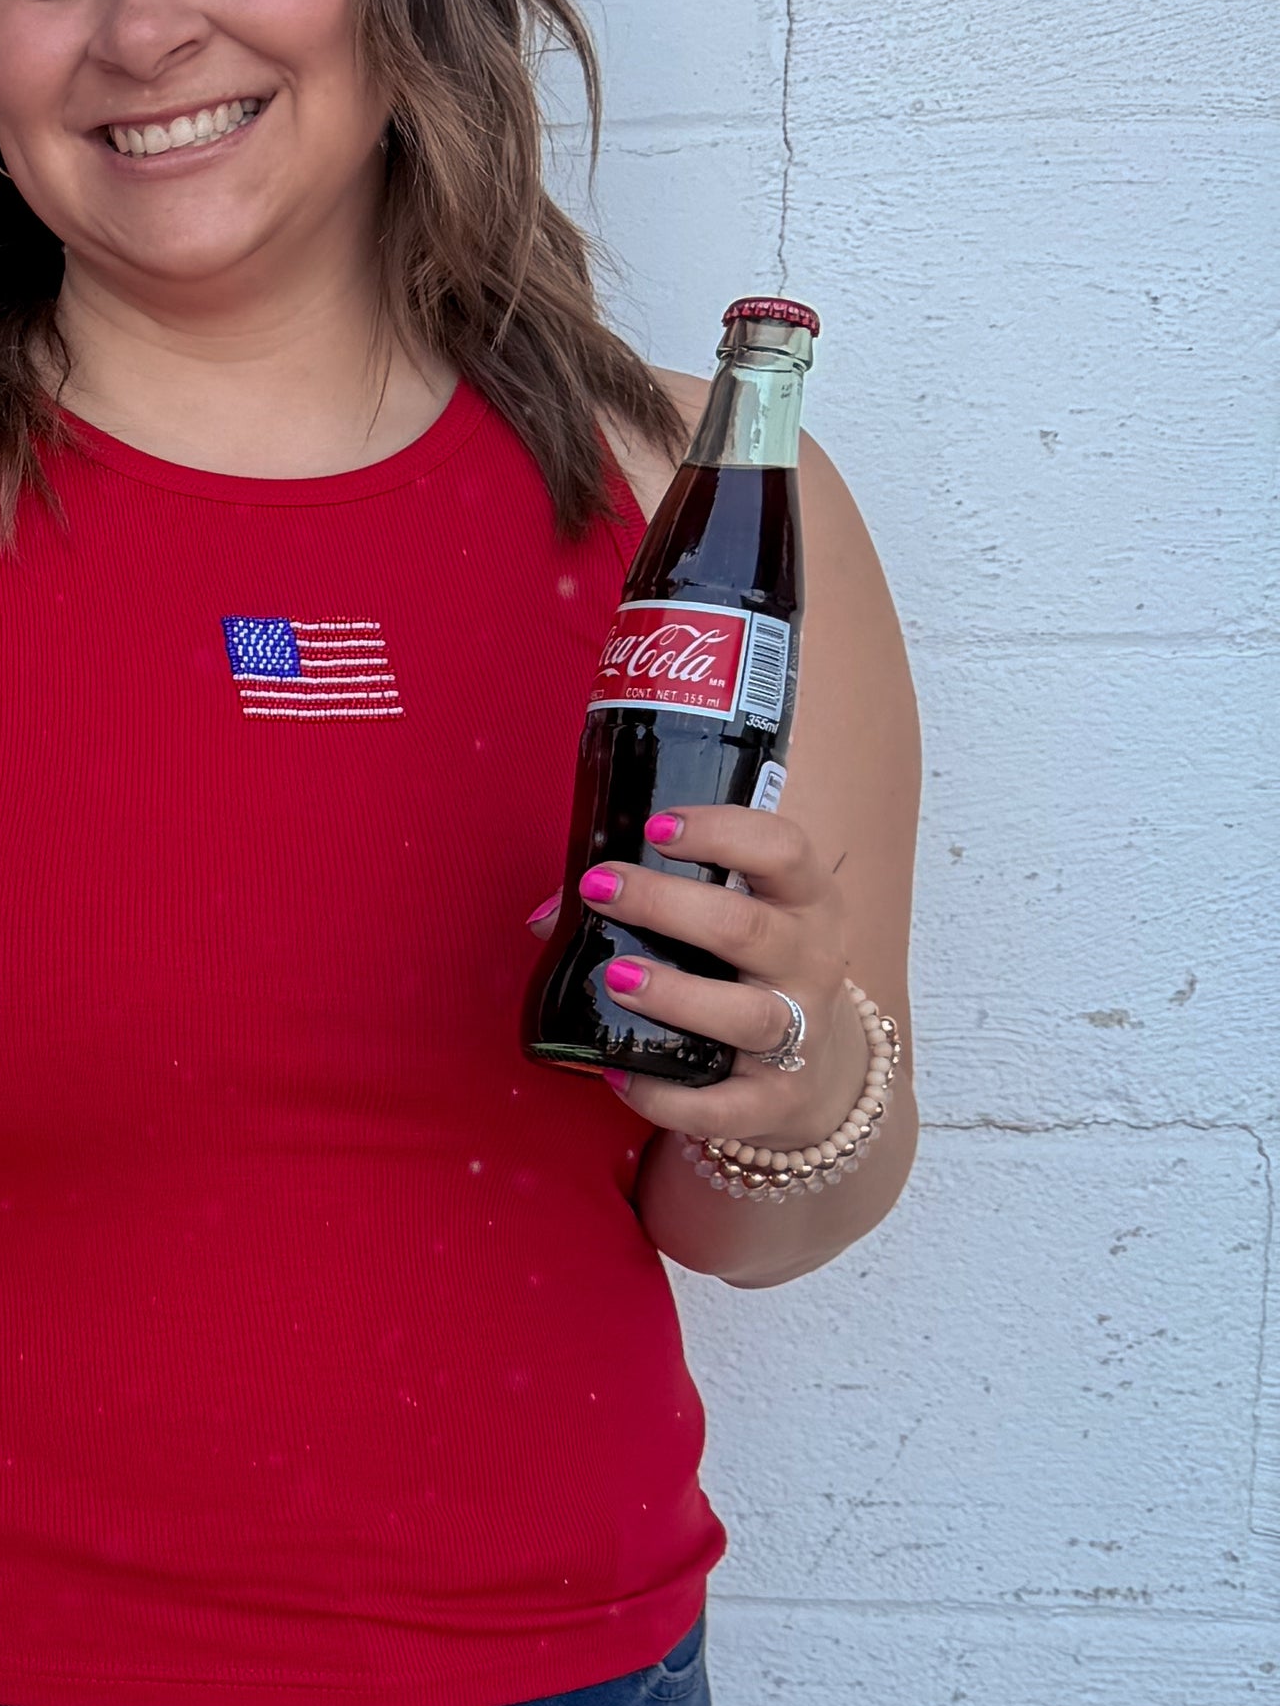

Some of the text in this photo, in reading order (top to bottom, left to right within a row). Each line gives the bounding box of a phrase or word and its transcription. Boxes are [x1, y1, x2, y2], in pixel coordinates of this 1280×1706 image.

[683, 692, 704, 705] 355
[706, 698, 721, 708] ml
[745, 714, 780, 735] 355ml
